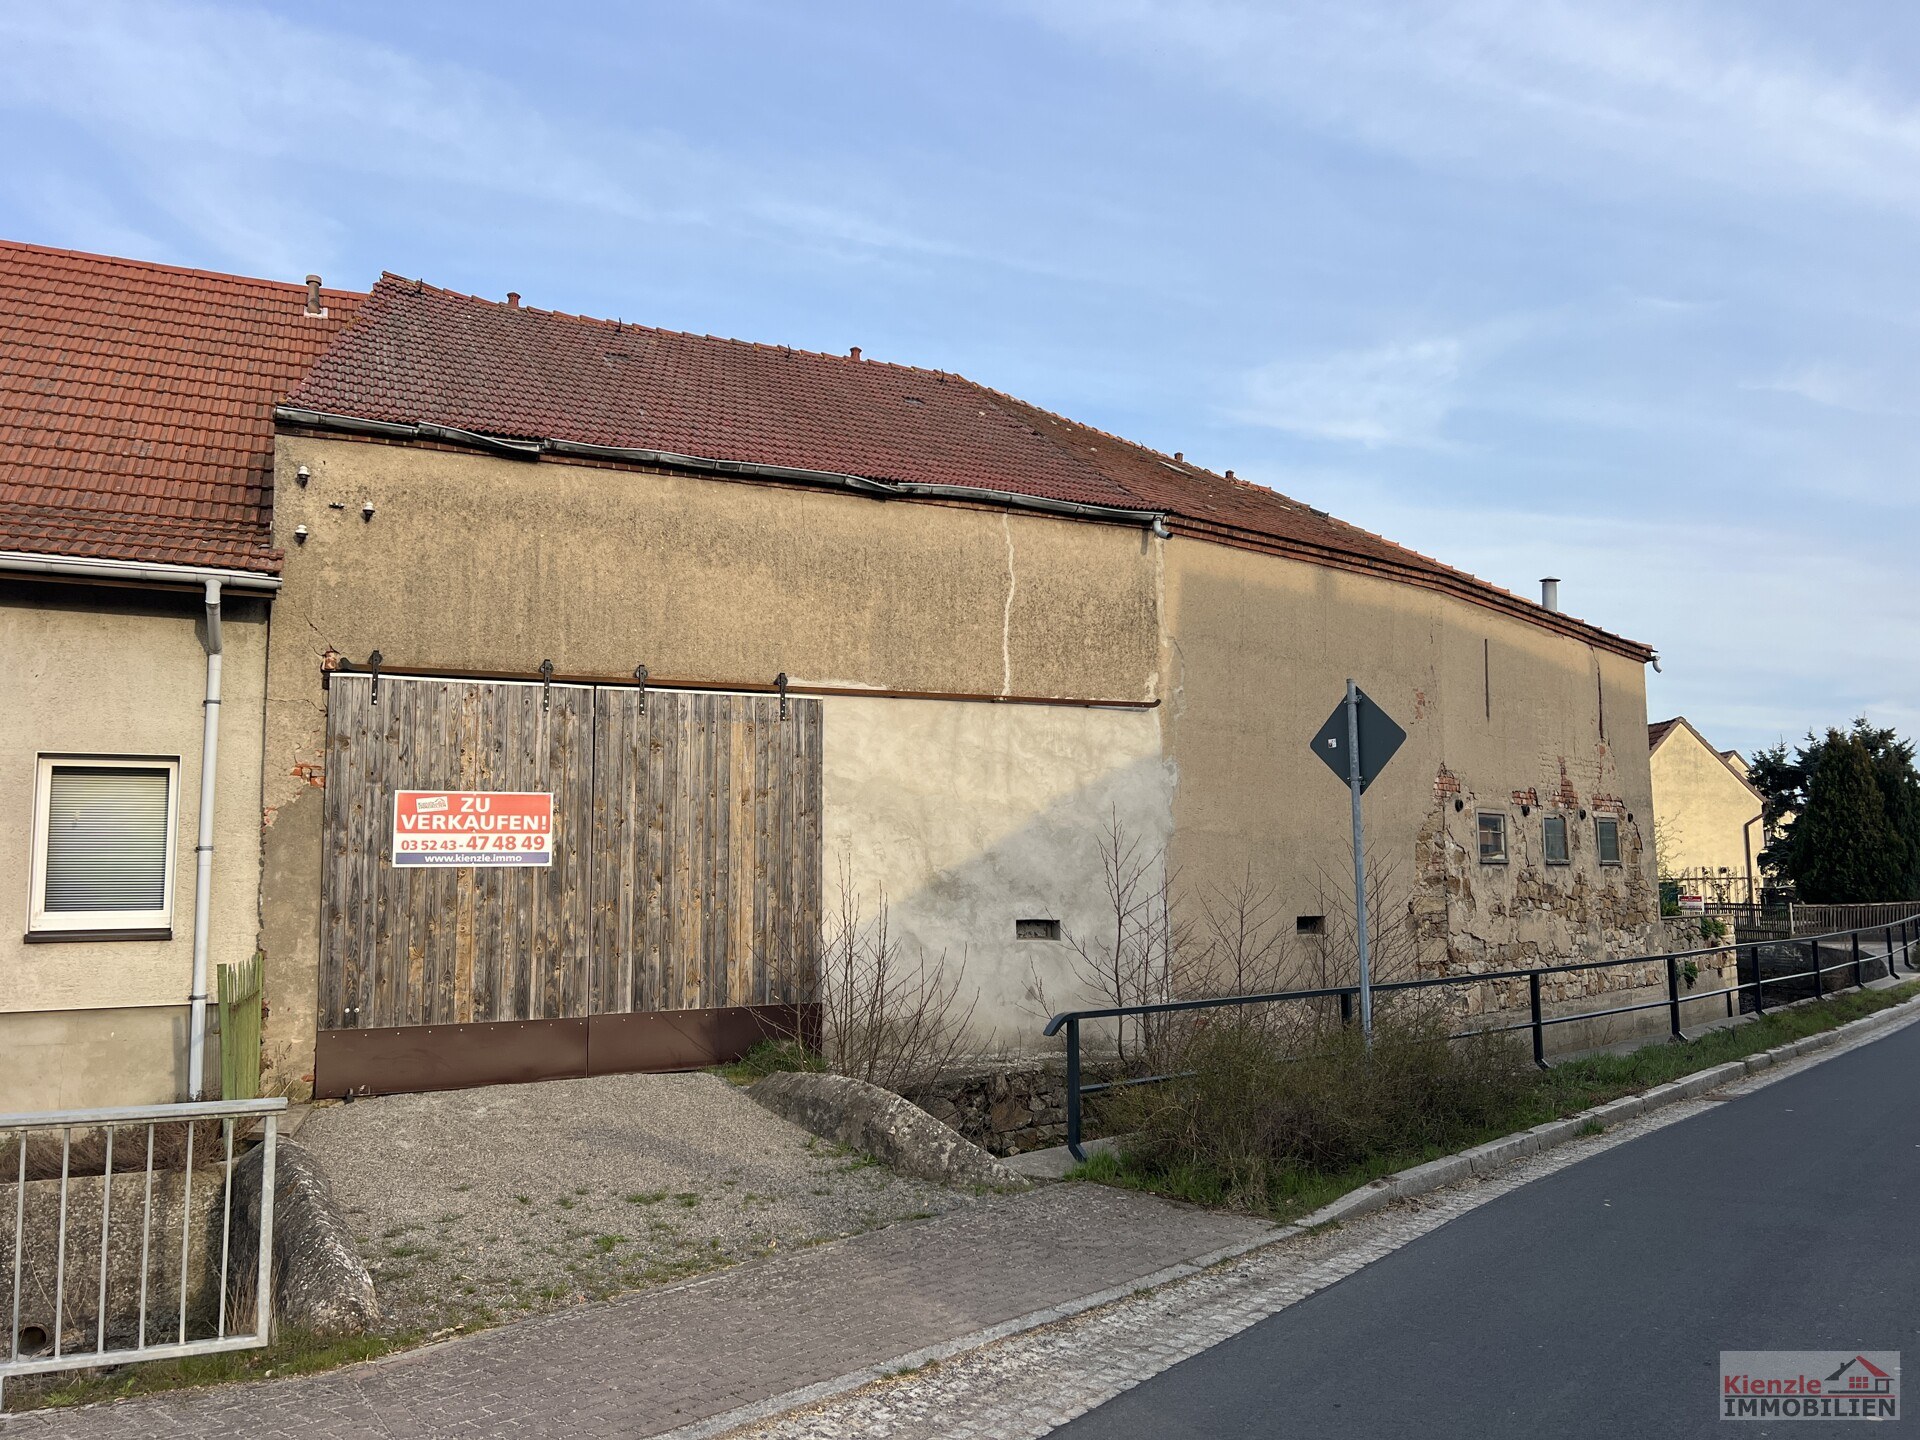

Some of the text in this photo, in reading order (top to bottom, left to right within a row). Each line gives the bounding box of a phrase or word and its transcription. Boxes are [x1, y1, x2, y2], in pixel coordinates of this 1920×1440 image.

[461, 797, 490, 812] ZU
[401, 814, 547, 830] VERKAUFEN!
[401, 840, 417, 850] 03
[421, 840, 437, 850] 52
[492, 835, 516, 850] 48
[521, 835, 545, 850] 49
[424, 854, 522, 863] www.kienzle.immo
